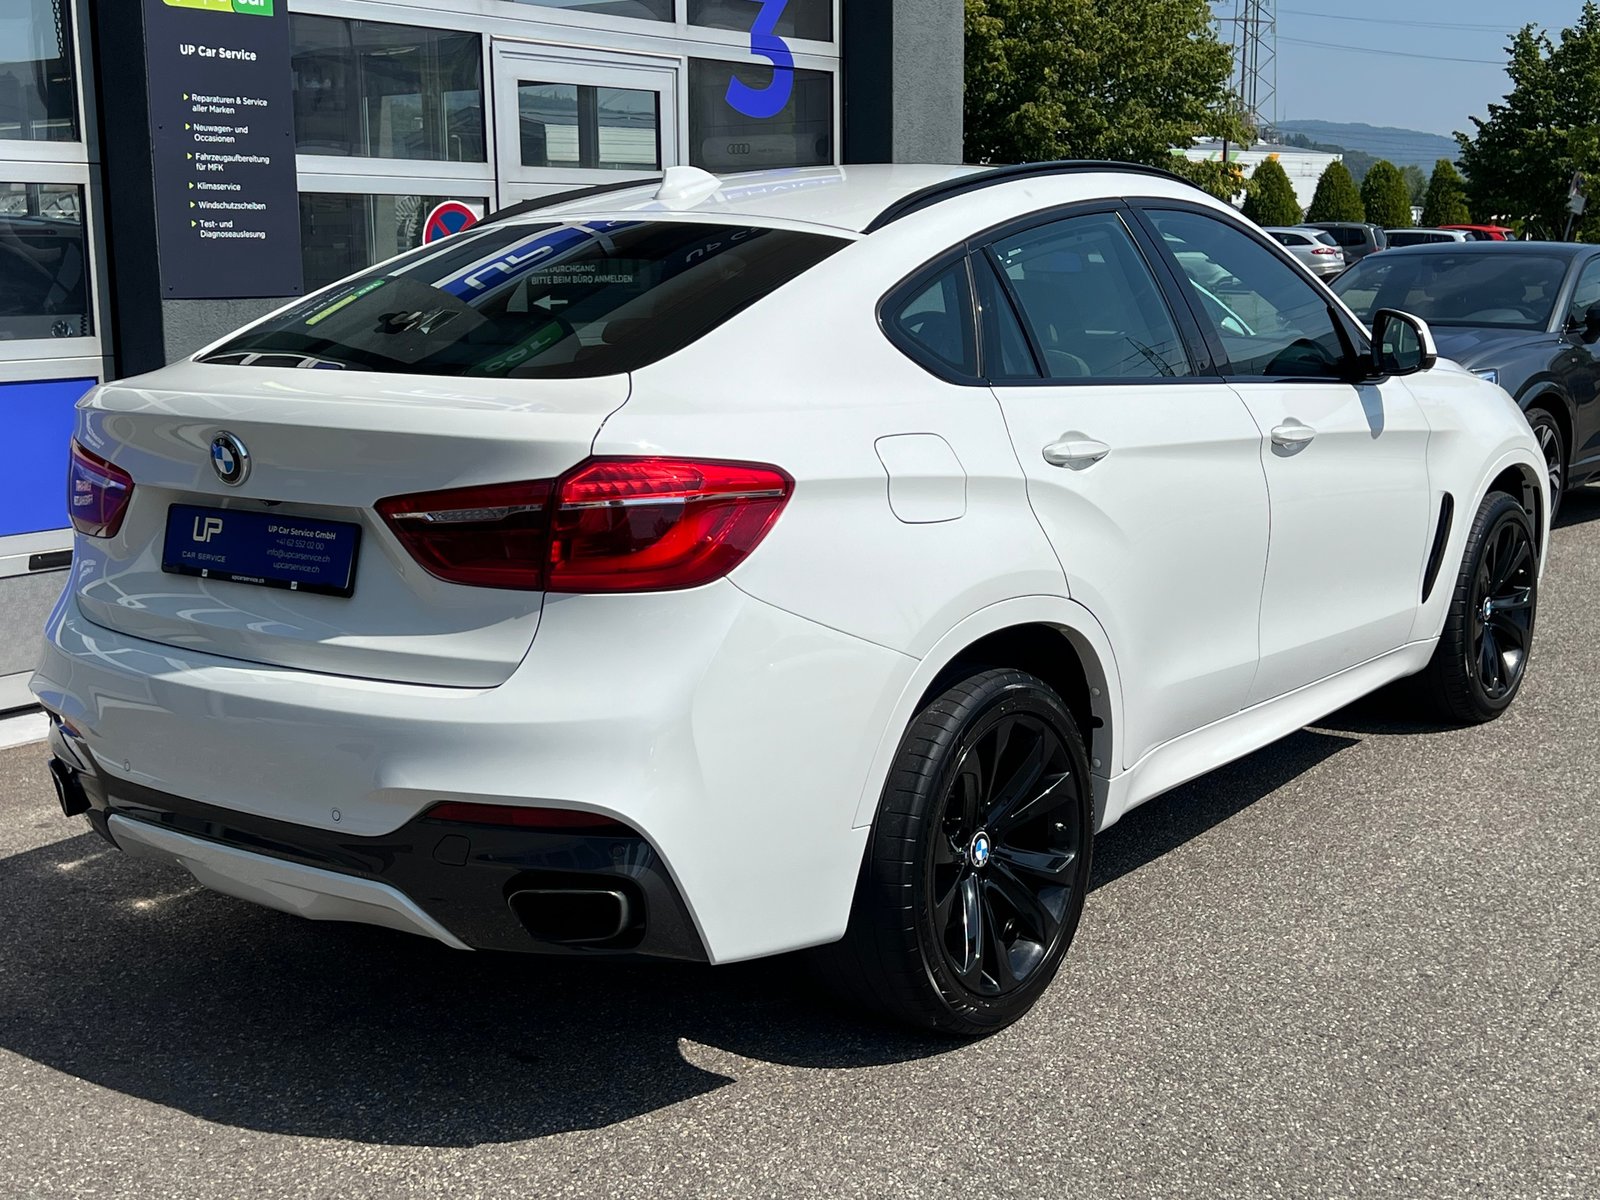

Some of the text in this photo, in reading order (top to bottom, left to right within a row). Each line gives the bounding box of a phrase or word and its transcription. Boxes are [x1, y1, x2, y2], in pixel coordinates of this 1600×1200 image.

[180, 44, 257, 61] UP Car Service
[725, 0, 795, 119] 3
[191, 93, 235, 105] Reparaturen
[243, 97, 268, 107] Service
[192, 105, 235, 115] aller Marken
[193, 123, 249, 134] Neuwagen- und
[194, 134, 235, 143] Occasionen
[195, 153, 270, 165] Fahrzeugaufbereitung
[196, 163, 224, 172] für MFK
[197, 182, 241, 191] Klimaservice
[198, 201, 266, 210] Windschutzscheiben
[200, 219, 233, 228] Test- und
[200, 230, 266, 240] Diagnoseauslesung
[531, 273, 633, 286] BITTE BEIM BÜRO ANMELDEN
[193, 516, 223, 543] UP
[268, 525, 337, 540] UP Car Service GmbH
[182, 551, 226, 563] CAR SERVICE
[273, 562, 320, 573] upcarservice.ch
